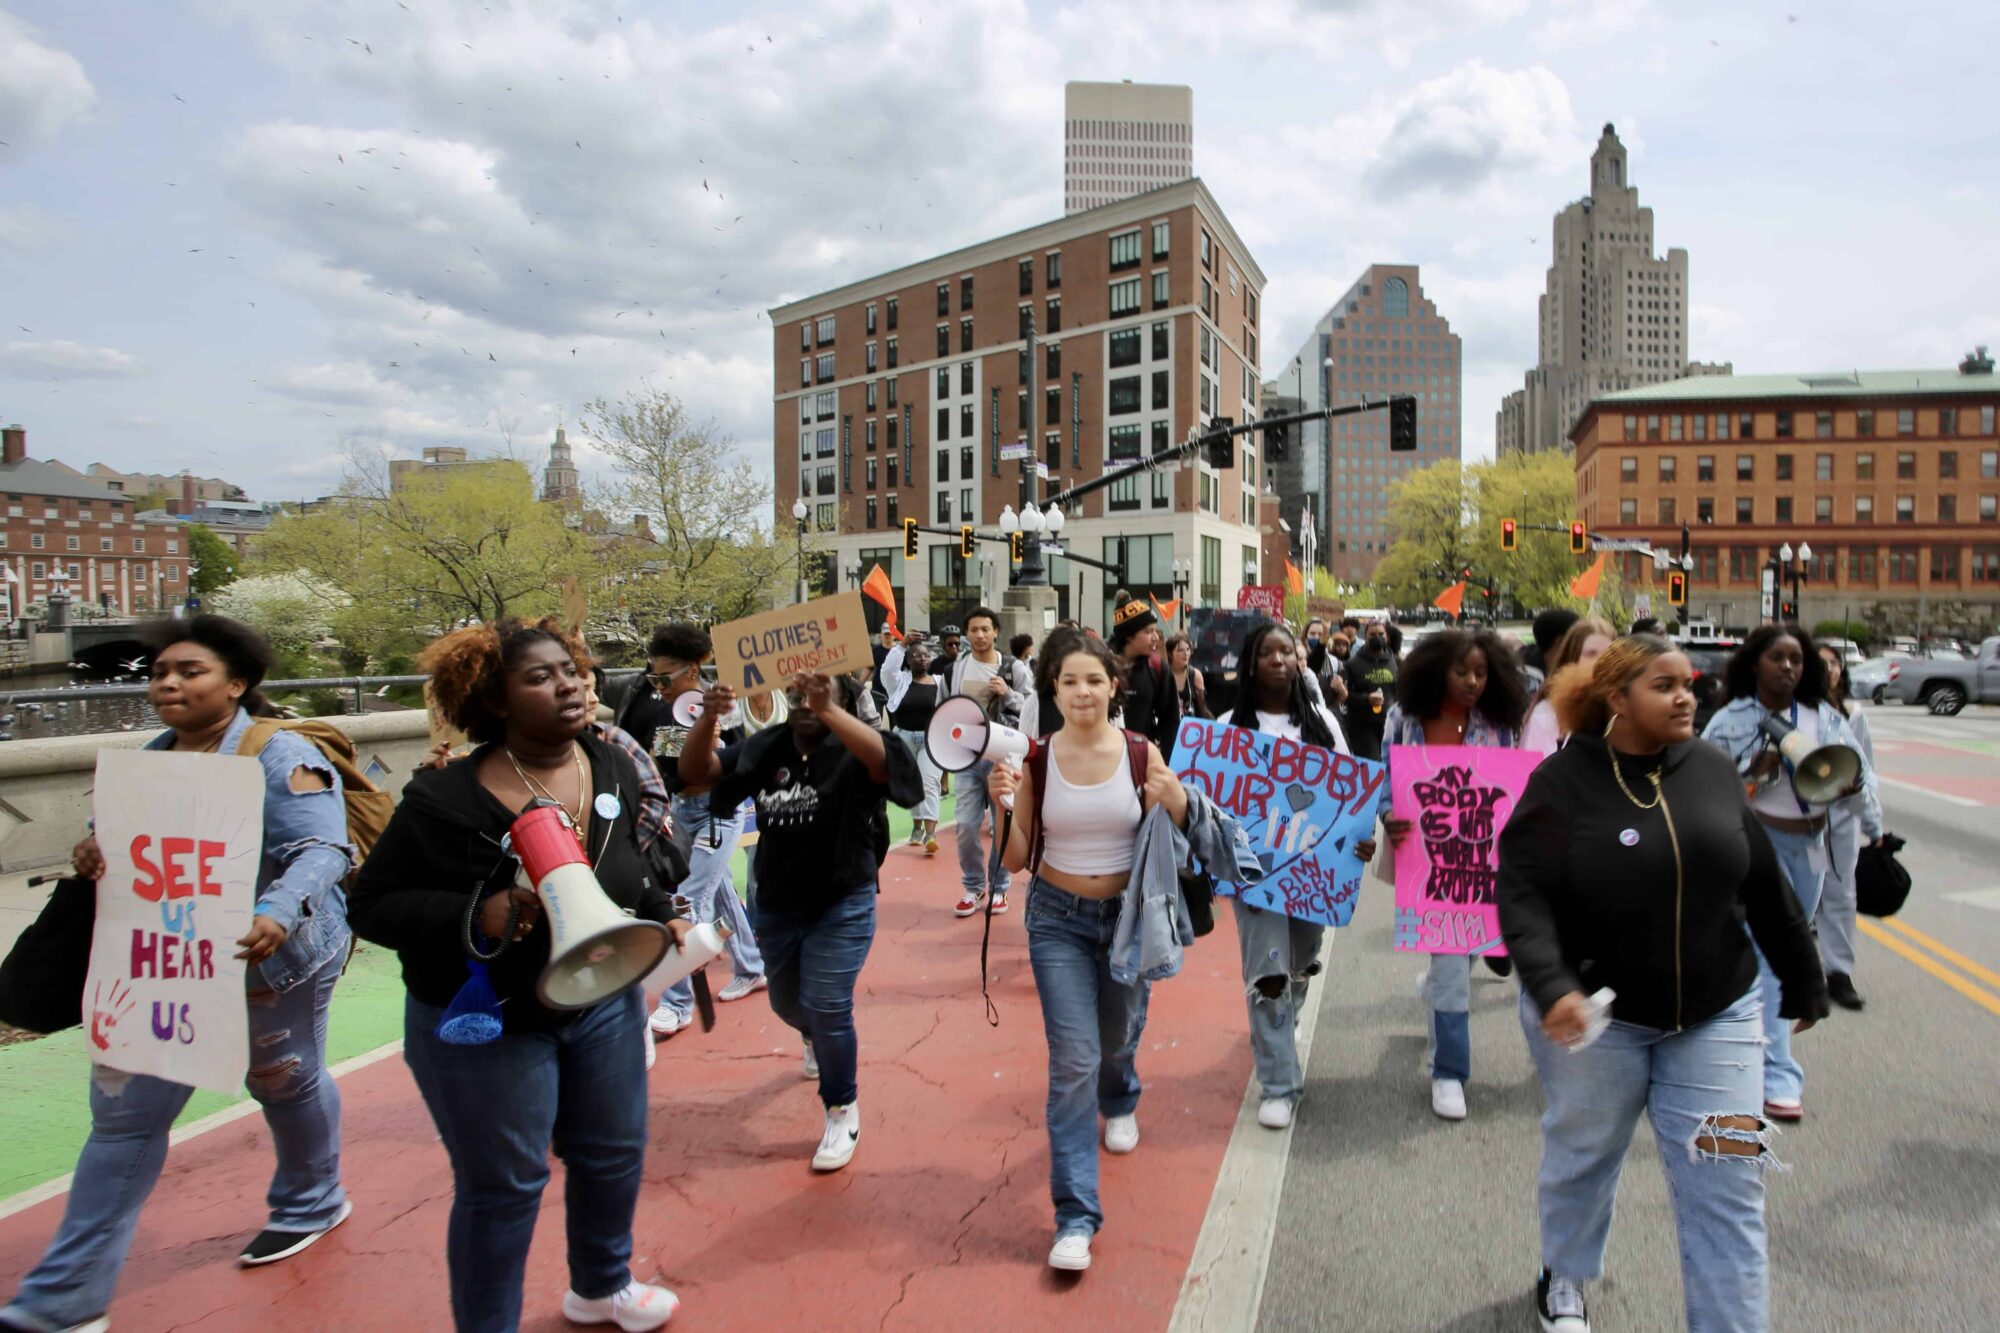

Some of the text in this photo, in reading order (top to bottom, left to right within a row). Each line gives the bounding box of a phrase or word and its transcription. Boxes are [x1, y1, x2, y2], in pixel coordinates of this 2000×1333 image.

[737, 619, 822, 660] CLOTHES
[776, 643, 848, 677] CONSENT
[1180, 722, 1259, 769] OUR
[1177, 768, 1276, 820] OUR
[1413, 782, 1507, 810] BODY
[1432, 765, 1472, 790] MY
[1420, 809, 1494, 840] IS NOT
[130, 834, 226, 902] SEE
[1426, 866, 1500, 905] PROPERT
[160, 901, 197, 941] US
[130, 929, 214, 980] HEAR
[152, 1001, 195, 1044] US
